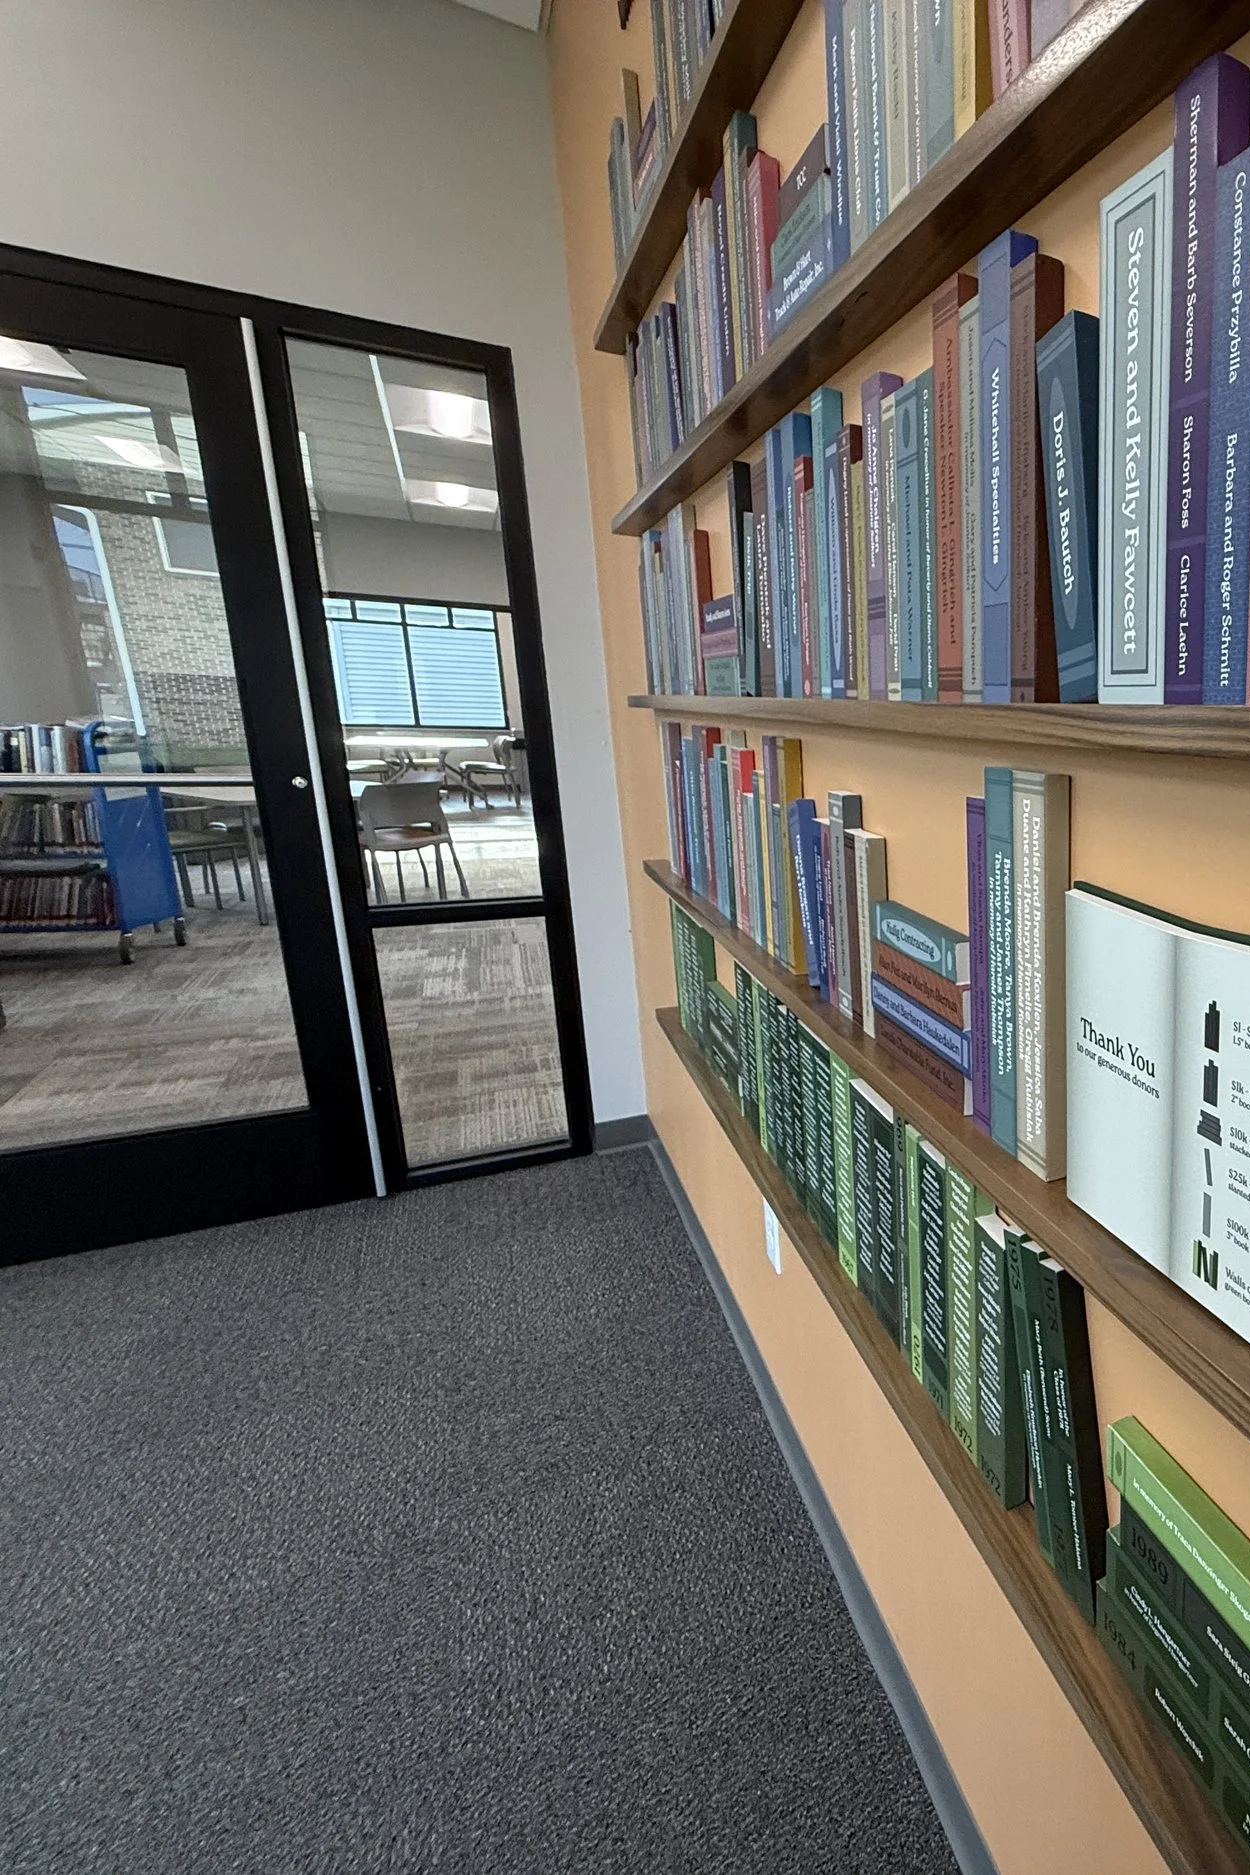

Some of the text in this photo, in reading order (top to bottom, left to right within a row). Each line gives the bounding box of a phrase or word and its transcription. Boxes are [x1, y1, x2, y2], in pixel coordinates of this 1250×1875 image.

[869, 6, 878, 81] National
[1184, 94, 1202, 384] Sherman and Barb Severson
[1228, 171, 1247, 384] Constance Przybilla
[990, 367, 1000, 565] Whitehall Specialties
[1122, 228, 1144, 655] Steven and Kelly Fawcett
[1181, 416, 1194, 528] Sharon Foss
[1052, 410, 1075, 596] Doris J. Bautch
[1220, 432, 1238, 687] Barbara and Roger Schmitt
[1178, 554, 1192, 676] Clarice Laehn
[1022, 798, 1031, 854] Duane
[1032, 816, 1042, 872] Daniel
[994, 850, 1002, 910] Tammy
[1004, 858, 1012, 914] Brenda
[1016, 883, 1022, 895] in
[1024, 856, 1032, 888] and
[1034, 875, 1042, 906] and
[900, 928, 935, 960] Contracting
[1004, 917, 1012, 970] Moore,
[1022, 891, 1032, 958] Kathryn
[1034, 910, 1042, 968] Brenda
[996, 944, 1004, 994] James
[1018, 950, 1024, 964] of
[1004, 974, 1012, 1018] Tanya
[1024, 1028, 1033, 1074] Gregg
[1035, 1038, 1043, 1094] Jessica
[1076, 1042, 1160, 1100] to our generous donors
[1080, 1017, 1156, 1079] Thank You
[1026, 1076, 1034, 1144] Kubisiak
[1230, 1126, 1248, 1144] $10k
[1228, 1168, 1248, 1188] $25k
[1228, 1182, 1250, 1202] slanted
[1226, 1218, 1250, 1240] $100k
[1234, 1236, 1250, 1253] book
[1008, 1240, 1022, 1290] 1975
[1224, 1282, 1242, 1300] green
[1225, 1266, 1246, 1291] Walls
[1046, 1276, 1058, 1333] 1978
[954, 1415, 973, 1454] 1972
[1134, 1478, 1140, 1492] In
[1140, 1489, 1166, 1522] memory
[1166, 1518, 1174, 1530] of
[1131, 1527, 1168, 1585] 1989
[1206, 1626, 1224, 1652] Sara
